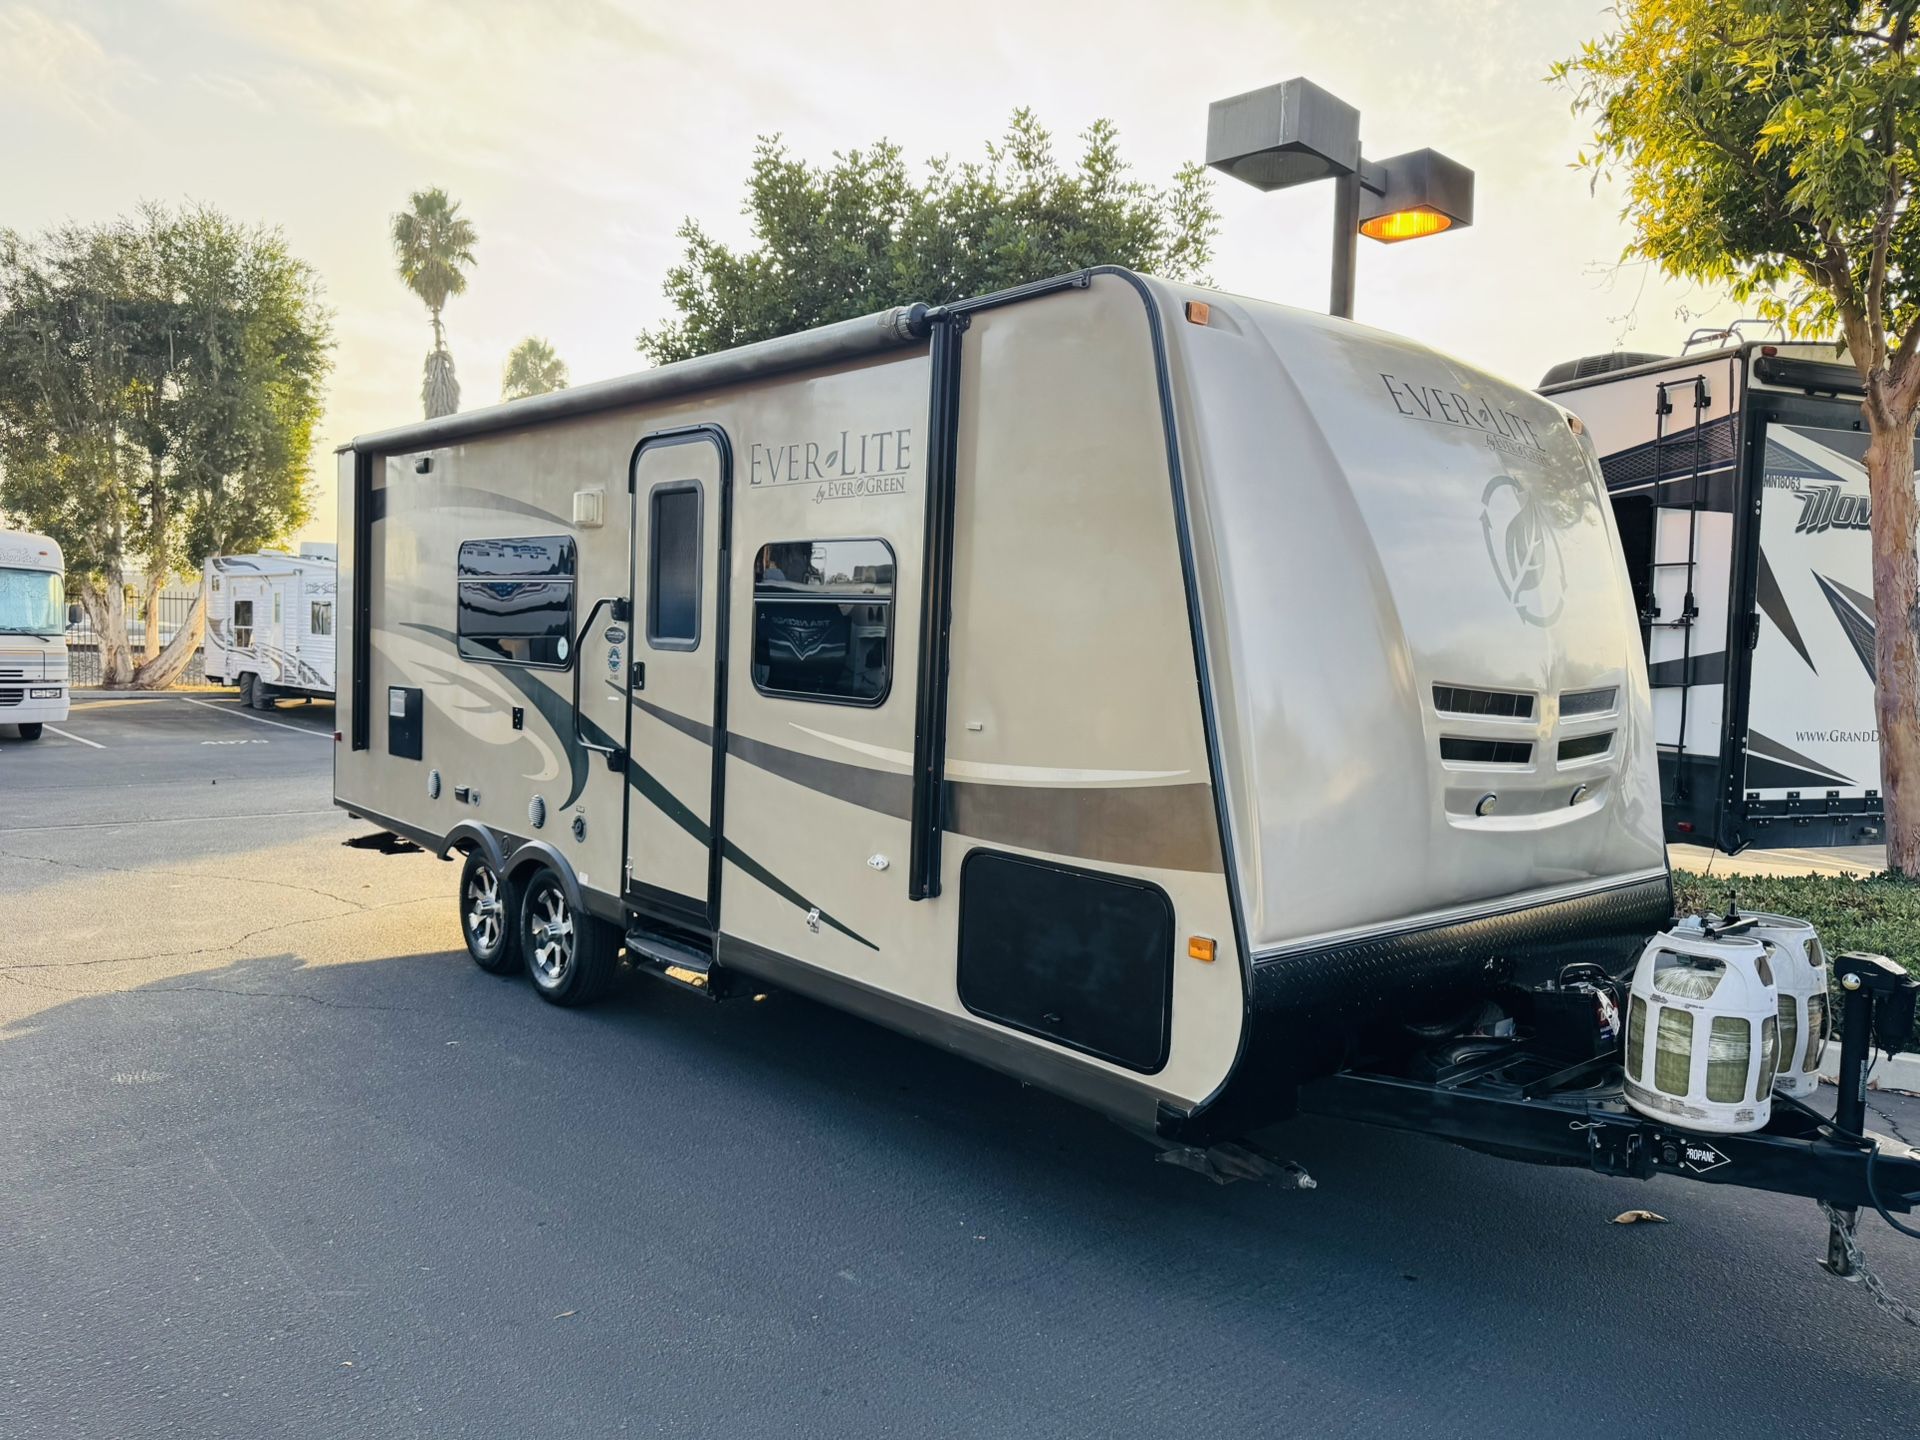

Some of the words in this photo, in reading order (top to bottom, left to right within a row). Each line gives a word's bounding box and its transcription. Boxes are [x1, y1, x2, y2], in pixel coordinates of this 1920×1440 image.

[1379, 373, 1485, 429] EVER
[1480, 397, 1546, 452] LITE
[750, 442, 823, 486] EVER
[840, 428, 912, 476] LITE
[828, 480, 855, 497] EVER
[866, 476, 906, 494] GREEN
[1686, 1147, 1716, 1164] PROPANE
